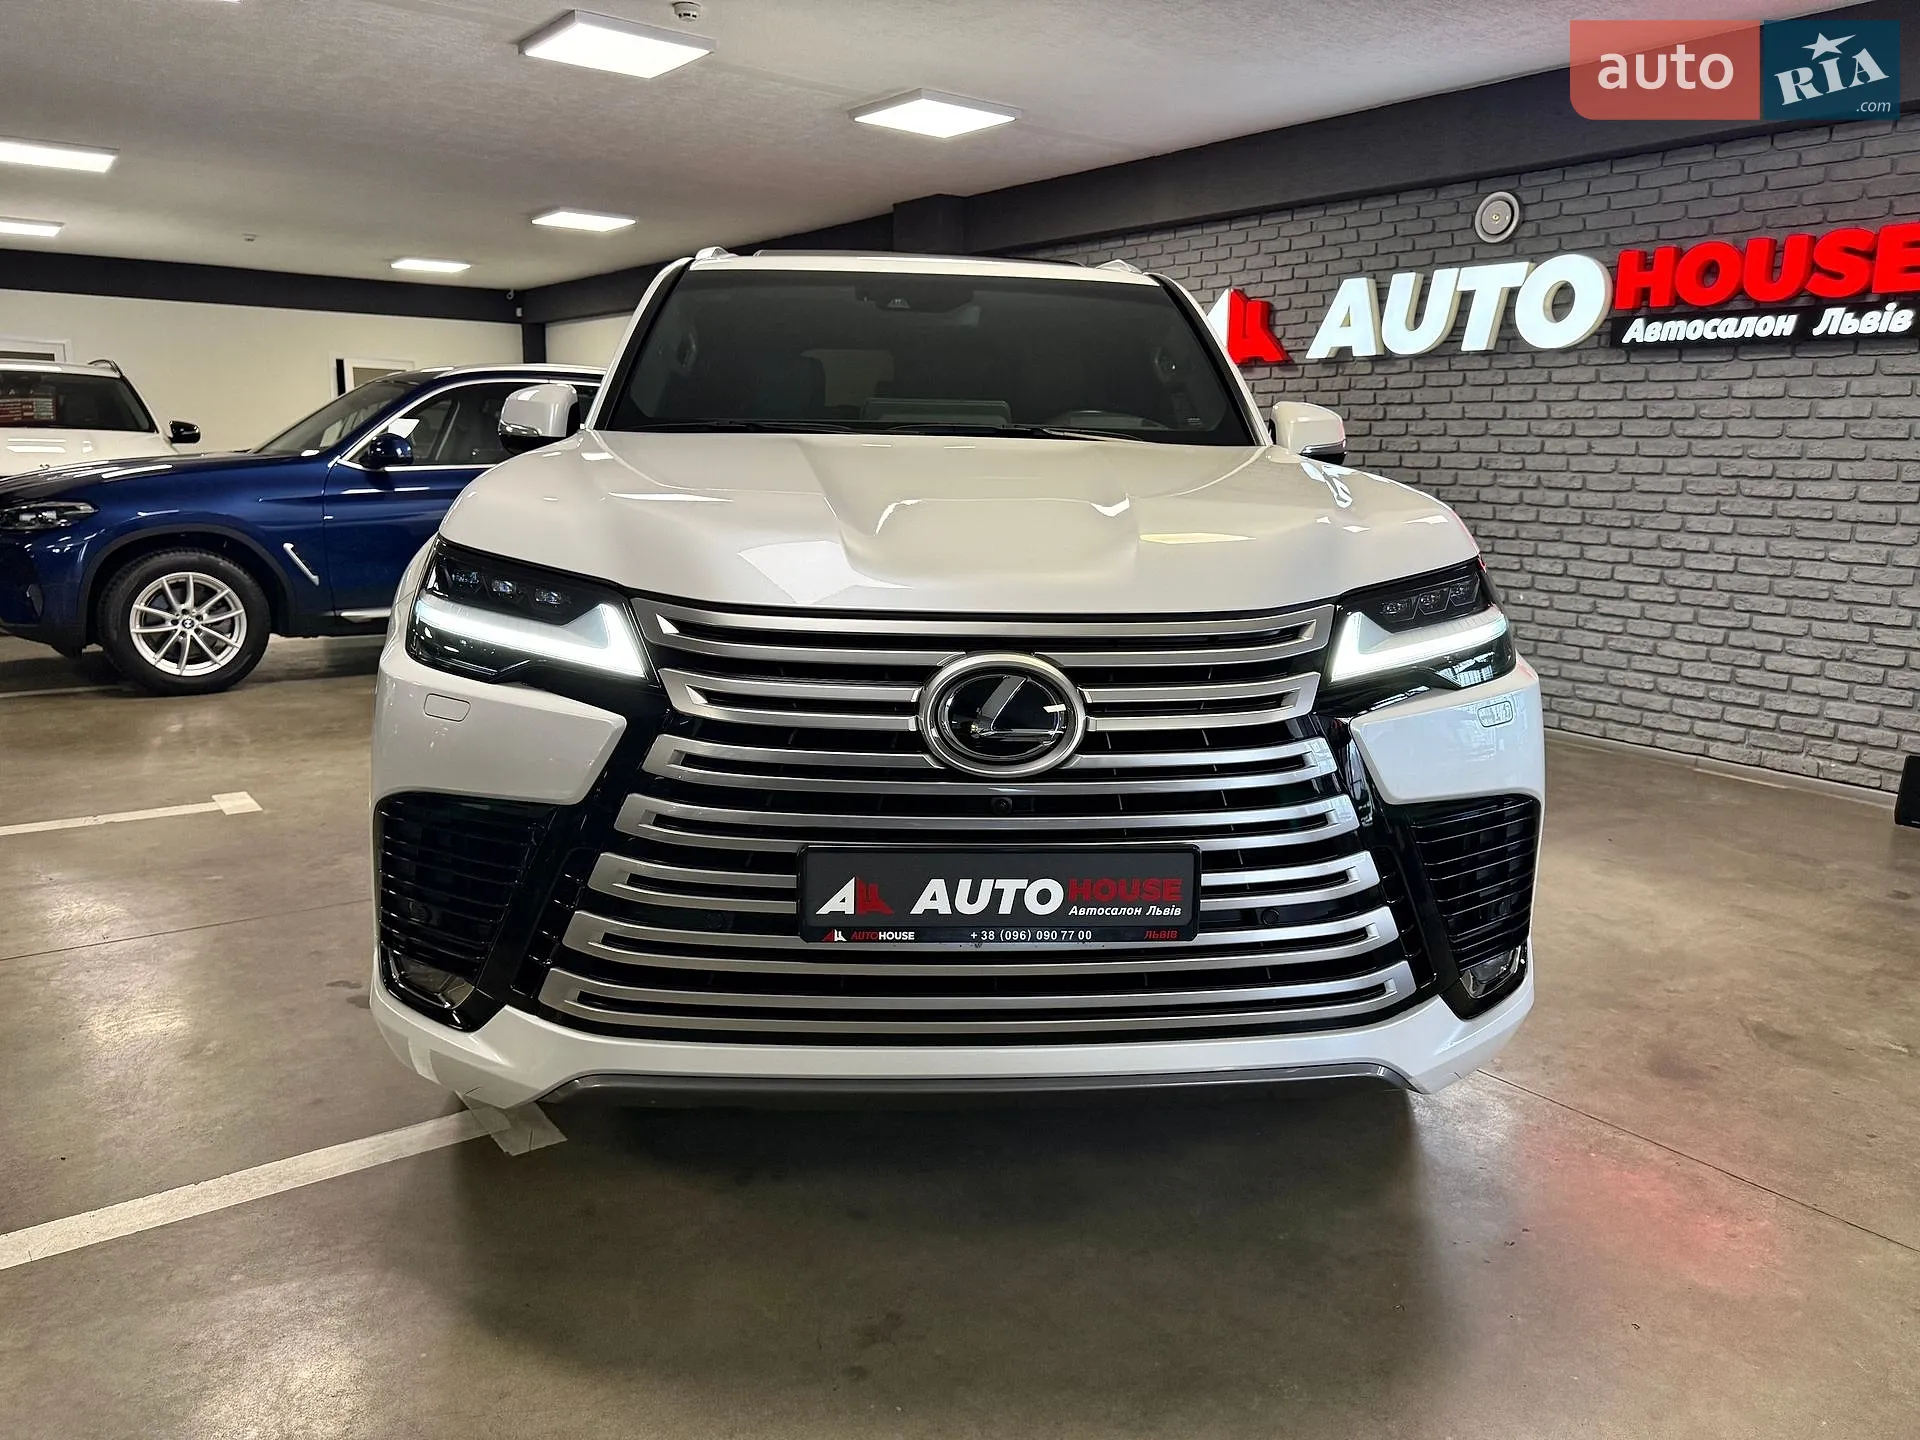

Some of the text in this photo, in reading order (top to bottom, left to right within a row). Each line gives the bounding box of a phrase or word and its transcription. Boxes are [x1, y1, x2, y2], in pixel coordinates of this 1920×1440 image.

[1306, 221, 1920, 360] AUTO HOUSE
[1621, 302, 1915, 345] Автосалон Львів
[909, 878, 1183, 915] AUTO HOUSE
[1068, 904, 1182, 916] Автосалон Львів
[851, 931, 915, 940] AUTOHOUSE
[1000, 929, 1031, 941] (096)
[1036, 930, 1057, 940] 090
[1060, 930, 1074, 940] 77
[1078, 930, 1092, 940] 00
